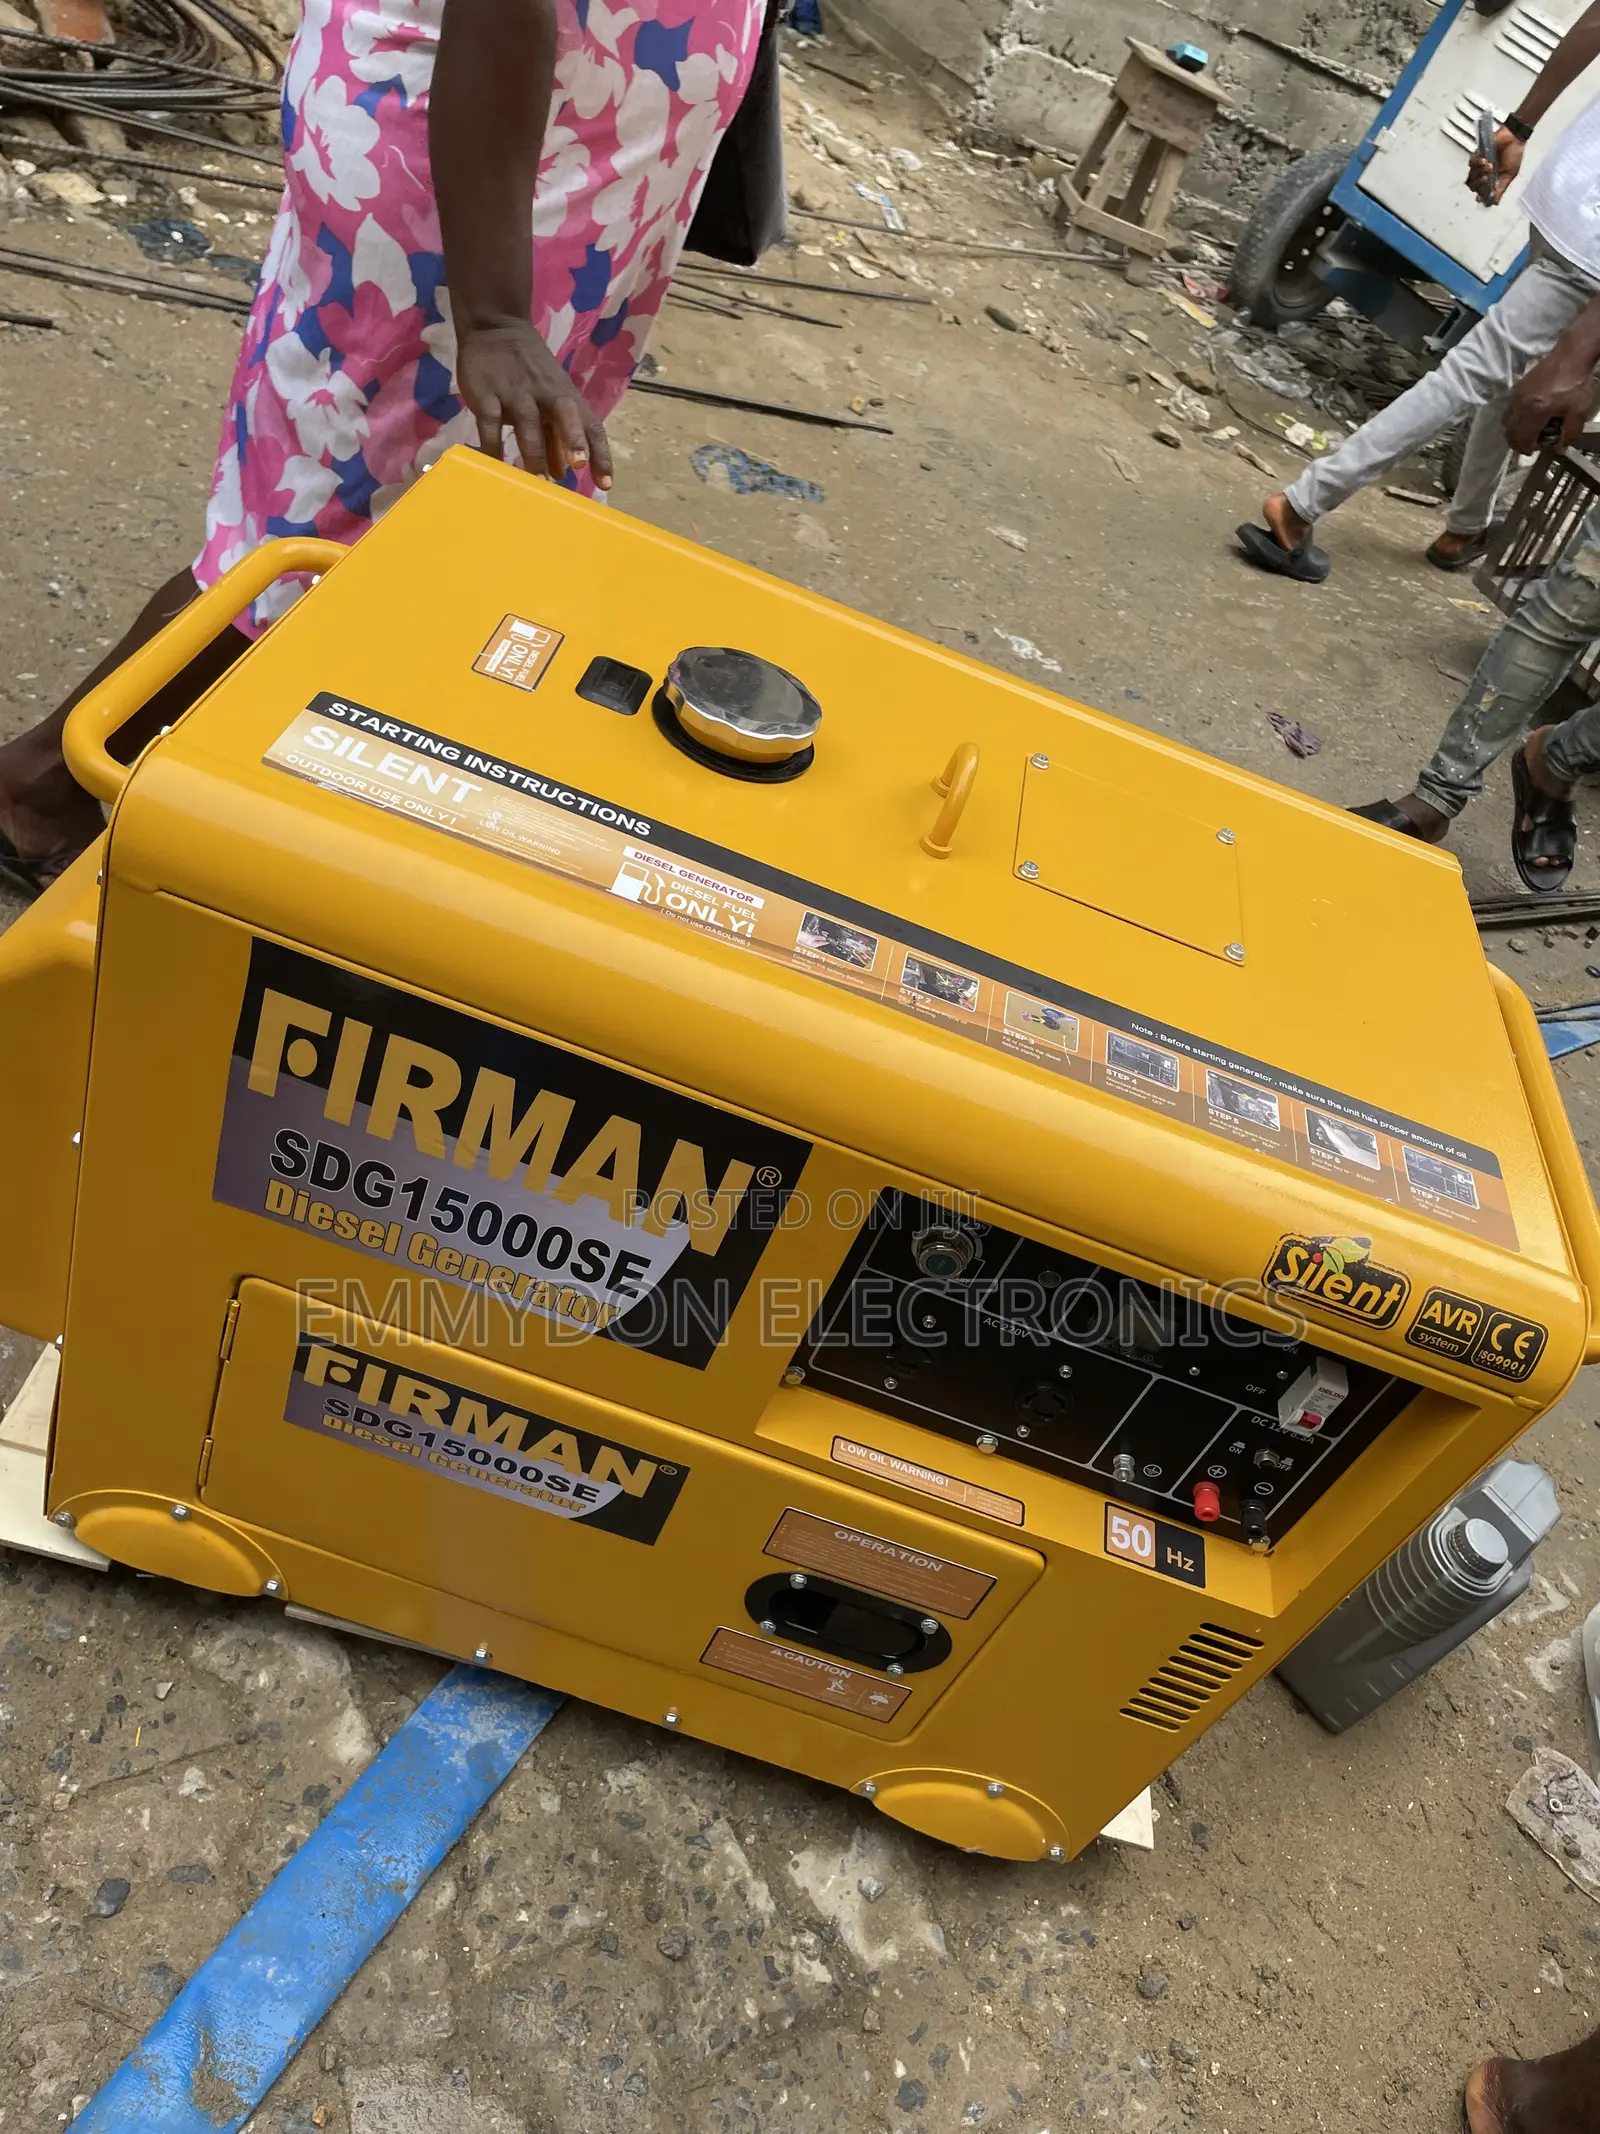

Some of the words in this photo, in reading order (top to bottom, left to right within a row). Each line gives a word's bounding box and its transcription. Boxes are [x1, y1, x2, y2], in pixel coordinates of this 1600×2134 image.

[496, 644, 529, 679] ONLY!
[286, 754, 368, 792] OUTDOOR
[369, 786, 402, 804] USE
[303, 725, 483, 804] SILENT
[328, 702, 462, 760] STARTING
[463, 754, 652, 836] INSTRUCTIONS
[502, 828, 516, 839] OIL
[518, 835, 562, 856] WARNING
[634, 851, 676, 874] DIESEL
[678, 870, 754, 904] GENERATOR
[665, 893, 756, 938] ONLY!
[670, 881, 720, 906] DIESEL
[722, 902, 759, 922] FUEL
[677, 915, 690, 924] not
[690, 919, 704, 928] use
[705, 925, 746, 946] GASOLINE
[794, 946, 819, 960] STEP
[899, 987, 923, 1001] STEP
[1002, 1028, 1027, 1041] STEP
[1106, 1068, 1130, 1081] STEP
[1131, 1022, 1153, 1036] Note
[1160, 1034, 1191, 1051] Before
[1192, 1047, 1227, 1066] starting
[1228, 1061, 1273, 1083] generator
[1279, 1080, 1304, 1095] make
[1305, 1092, 1326, 1104] sure
[1327, 1099, 1342, 1110] the
[1343, 1107, 1361, 1117] unit
[1362, 1112, 1378, 1124] has
[1380, 1120, 1409, 1136] proper
[1411, 1133, 1444, 1151] amount
[1445, 1145, 1455, 1154] of
[1456, 1150, 1467, 1160] oil
[247, 987, 756, 1257] FIRMAN
[1208, 1108, 1232, 1121] STEP
[1309, 1147, 1334, 1162] STEP
[1410, 1186, 1434, 1201] STEP
[269, 1127, 653, 1299] SDG15000SE
[264, 1177, 398, 1257] Diesel
[405, 1230, 623, 1330] Generator
[1274, 1246, 1402, 1319] Silent
[982, 1316, 1000, 1329] AC
[1000, 1322, 1031, 1339] 220V
[1422, 1300, 1478, 1336] AVR
[1281, 1344, 1299, 1355] ON
[1417, 1331, 1459, 1353] system
[1491, 1322, 1535, 1360] CE
[1477, 1349, 1526, 1373] ISO9001
[1245, 1383, 1267, 1396] OFF
[1318, 1386, 1345, 1400] DELIXI
[303, 1344, 658, 1499] FIRMAN
[1250, 1415, 1269, 1427] DC
[321, 1414, 422, 1459] Diesel
[427, 1450, 587, 1514] Generator
[322, 1396, 601, 1504] SDG15000SE
[840, 1441, 867, 1458] LOW
[869, 1451, 887, 1466] OIL
[889, 1458, 949, 1487] WARNING!
[1228, 1446, 1243, 1455] ON
[834, 1530, 943, 1573] OPERATION
[1110, 1515, 1152, 1557] 50
[1166, 1546, 1195, 1572] Hz
[783, 1650, 852, 1679] CAUTION
